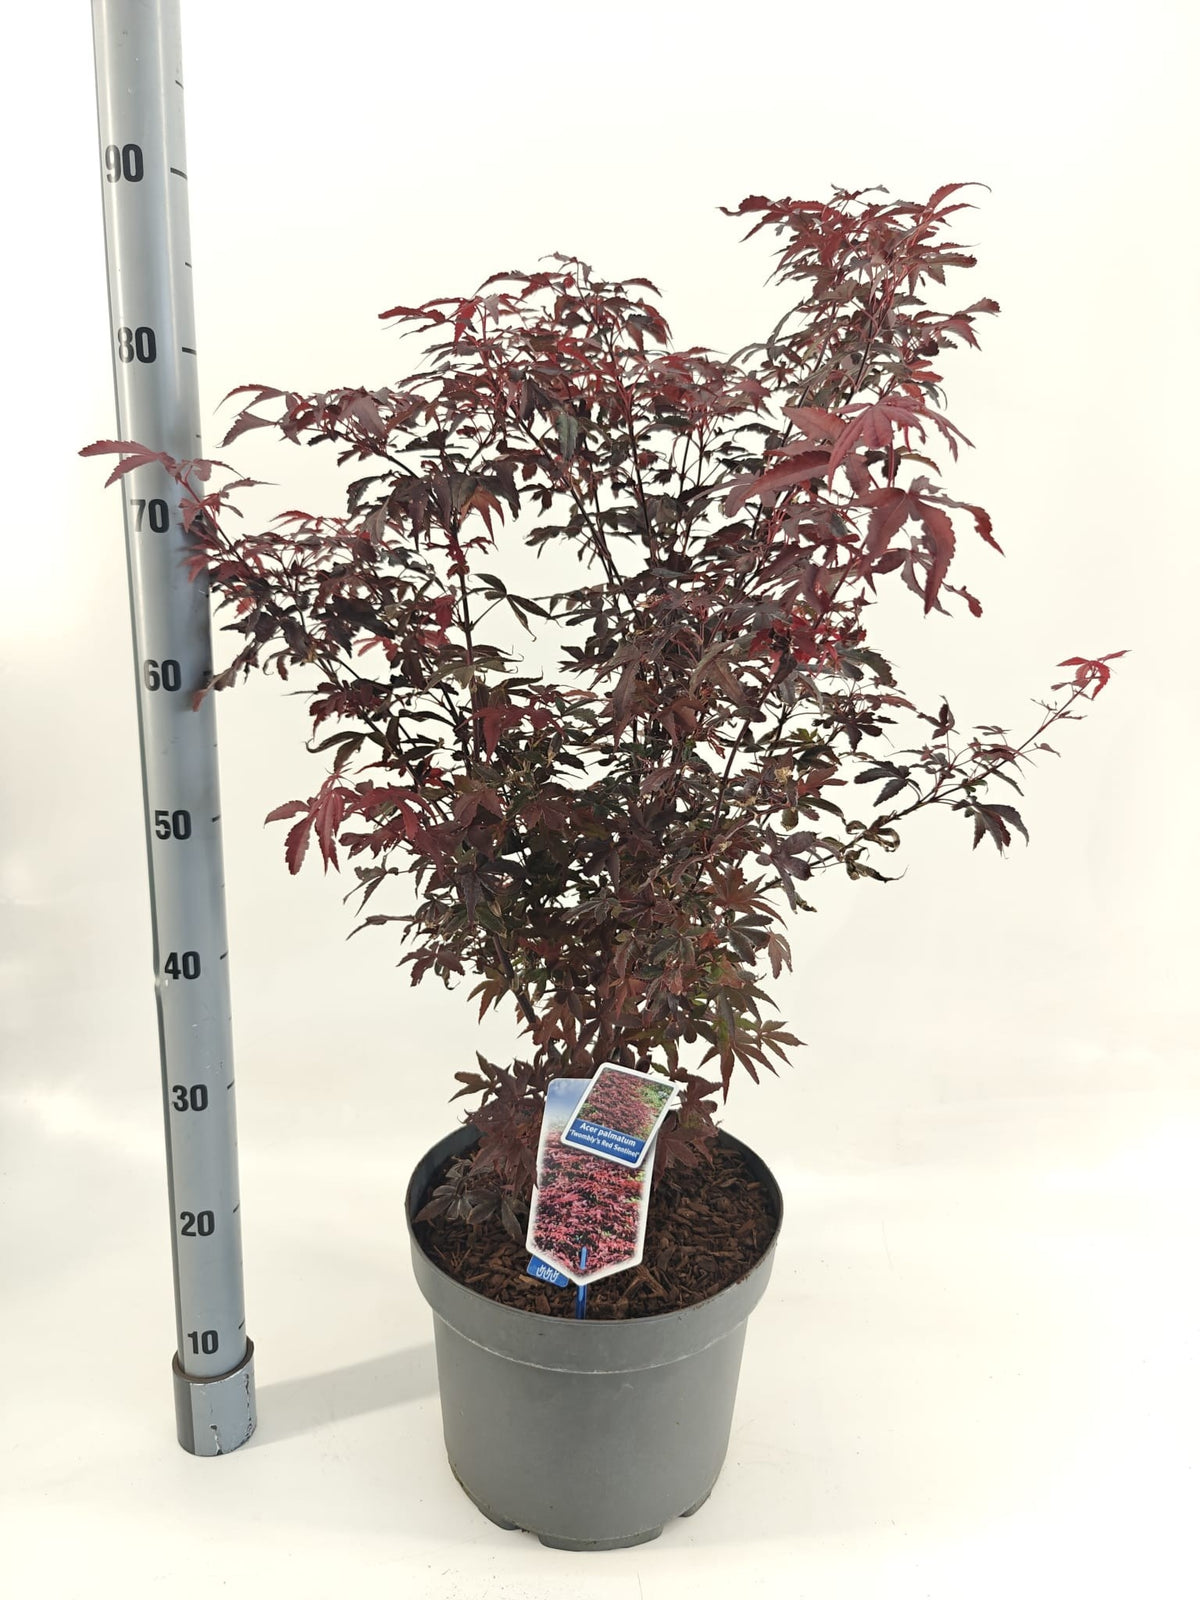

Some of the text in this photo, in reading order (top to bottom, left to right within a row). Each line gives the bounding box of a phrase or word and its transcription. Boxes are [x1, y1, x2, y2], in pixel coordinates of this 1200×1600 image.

[105, 143, 144, 183] 90
[119, 326, 157, 364] 80
[130, 498, 170, 534] 70
[144, 659, 182, 692] 60
[155, 809, 191, 840] 50
[164, 950, 201, 980] 40
[171, 1084, 208, 1112] 30
[580, 1122, 636, 1147] Acer palmatum
[601, 1140, 613, 1149] Red
[181, 1210, 215, 1237] 20
[187, 1330, 219, 1355] 10
